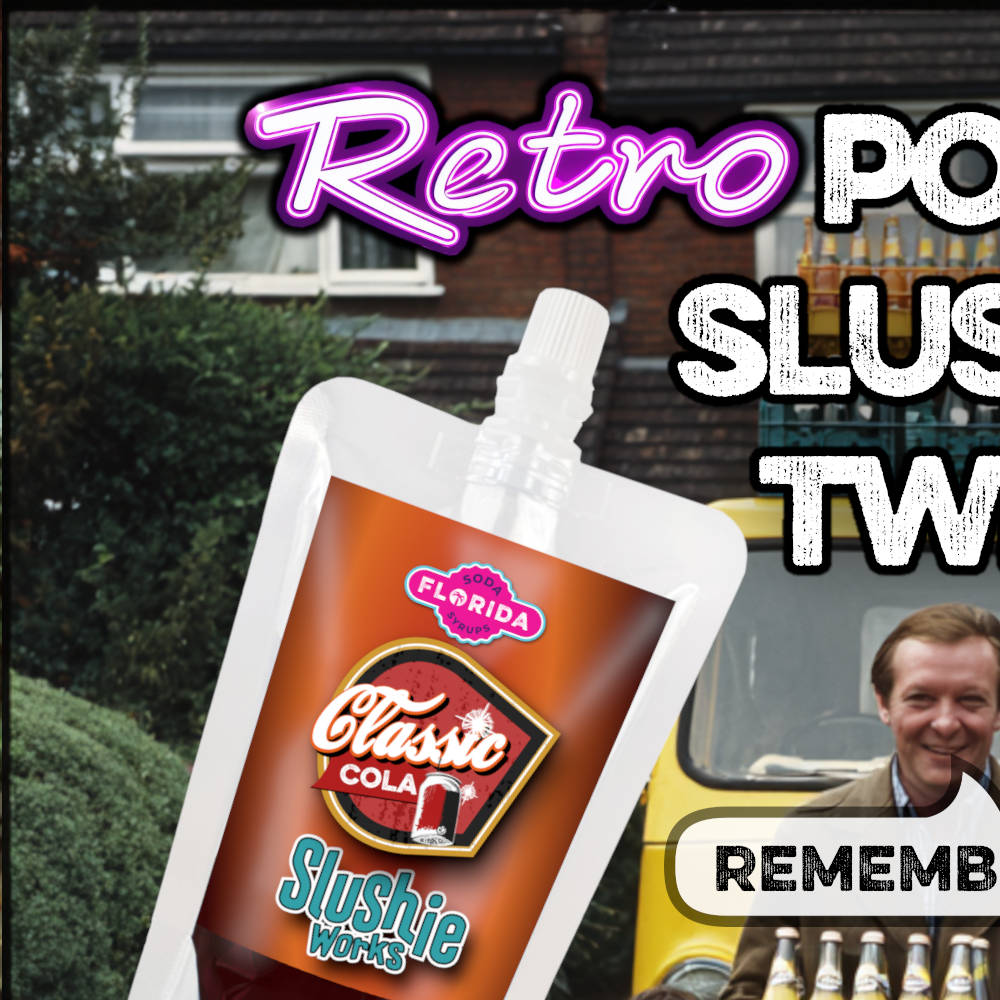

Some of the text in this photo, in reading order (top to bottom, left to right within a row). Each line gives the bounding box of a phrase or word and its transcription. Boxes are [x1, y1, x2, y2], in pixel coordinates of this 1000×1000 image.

[463, 573, 501, 596] SODA
[417, 575, 530, 632] FLORIDA
[447, 611, 491, 635] SYRUPS
[311, 683, 509, 772] Classic
[339, 764, 418, 796] COLA
